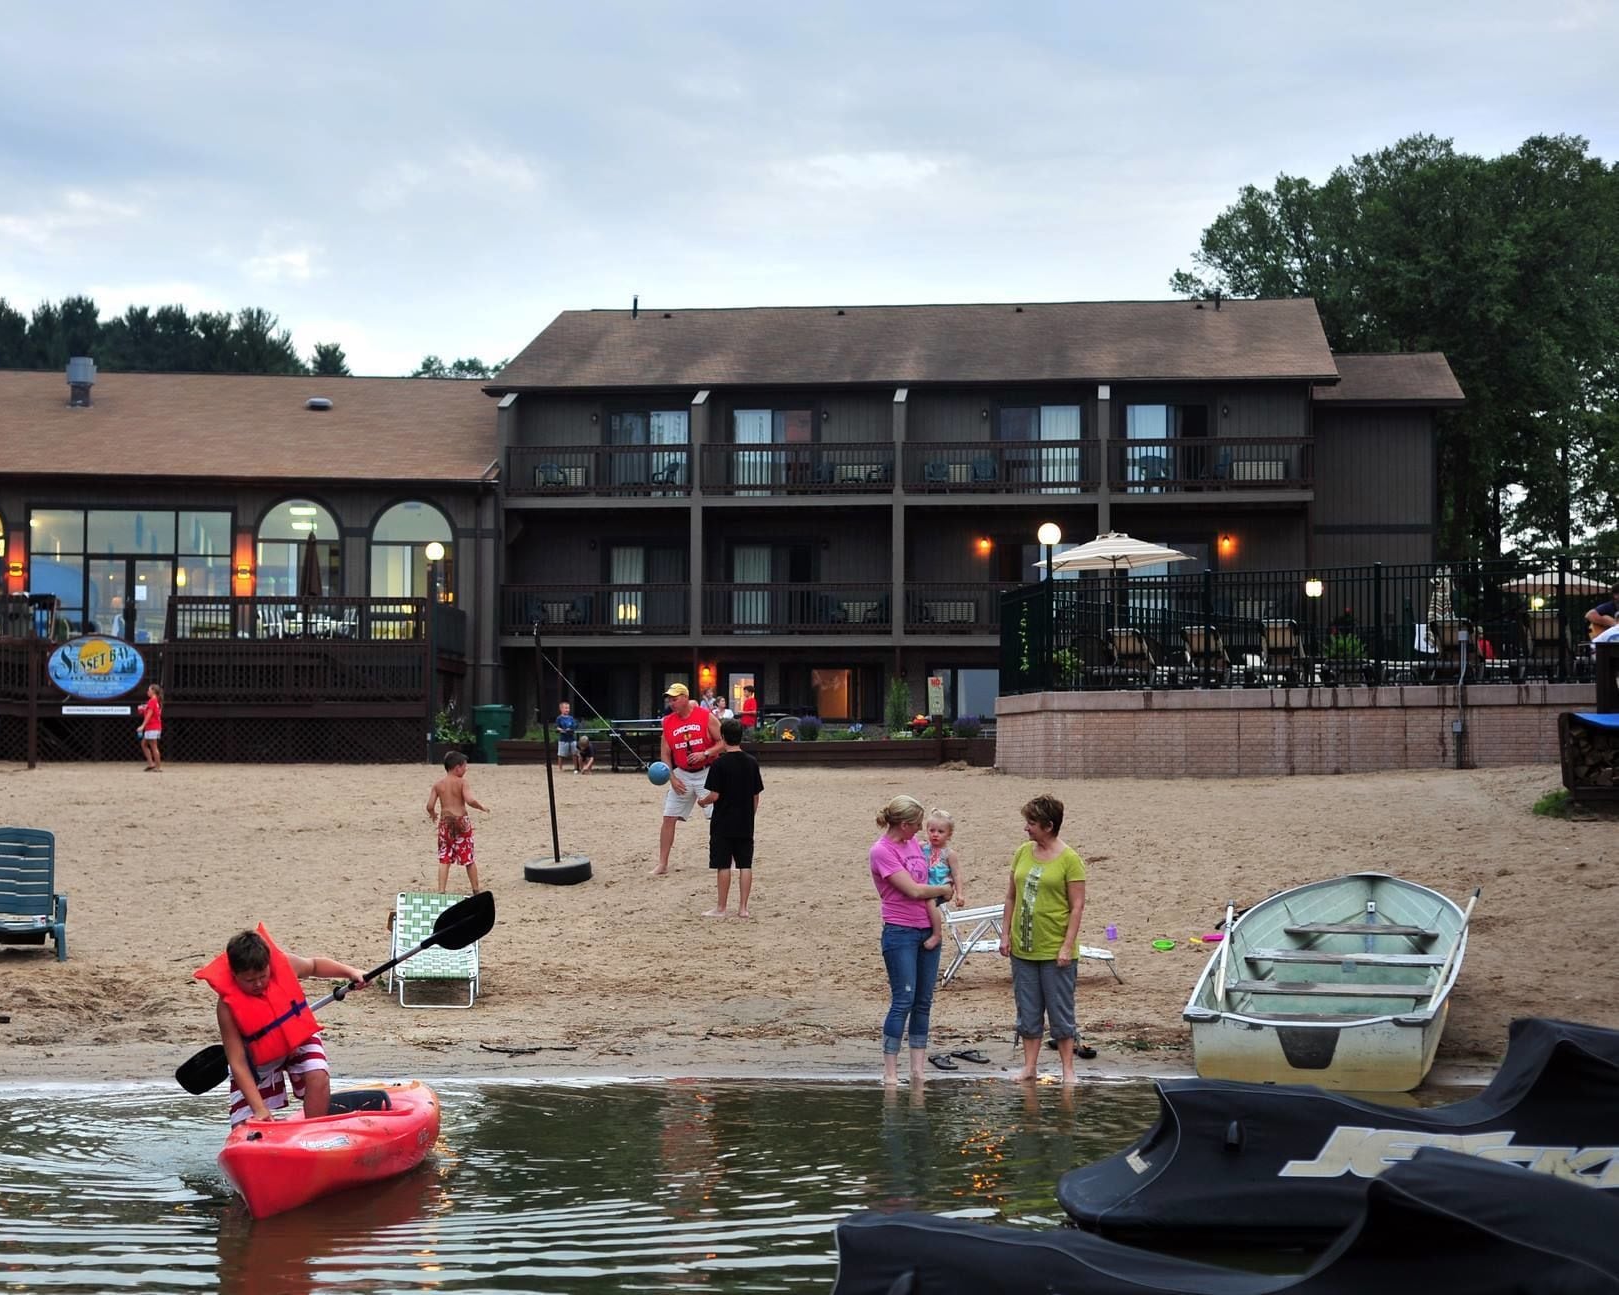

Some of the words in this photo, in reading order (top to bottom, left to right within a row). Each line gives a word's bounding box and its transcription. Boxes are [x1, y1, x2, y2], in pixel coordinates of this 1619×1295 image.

[54, 644, 106, 680] SUNSET
[109, 646, 130, 662] BAY
[673, 724, 701, 736] CHICAGO
